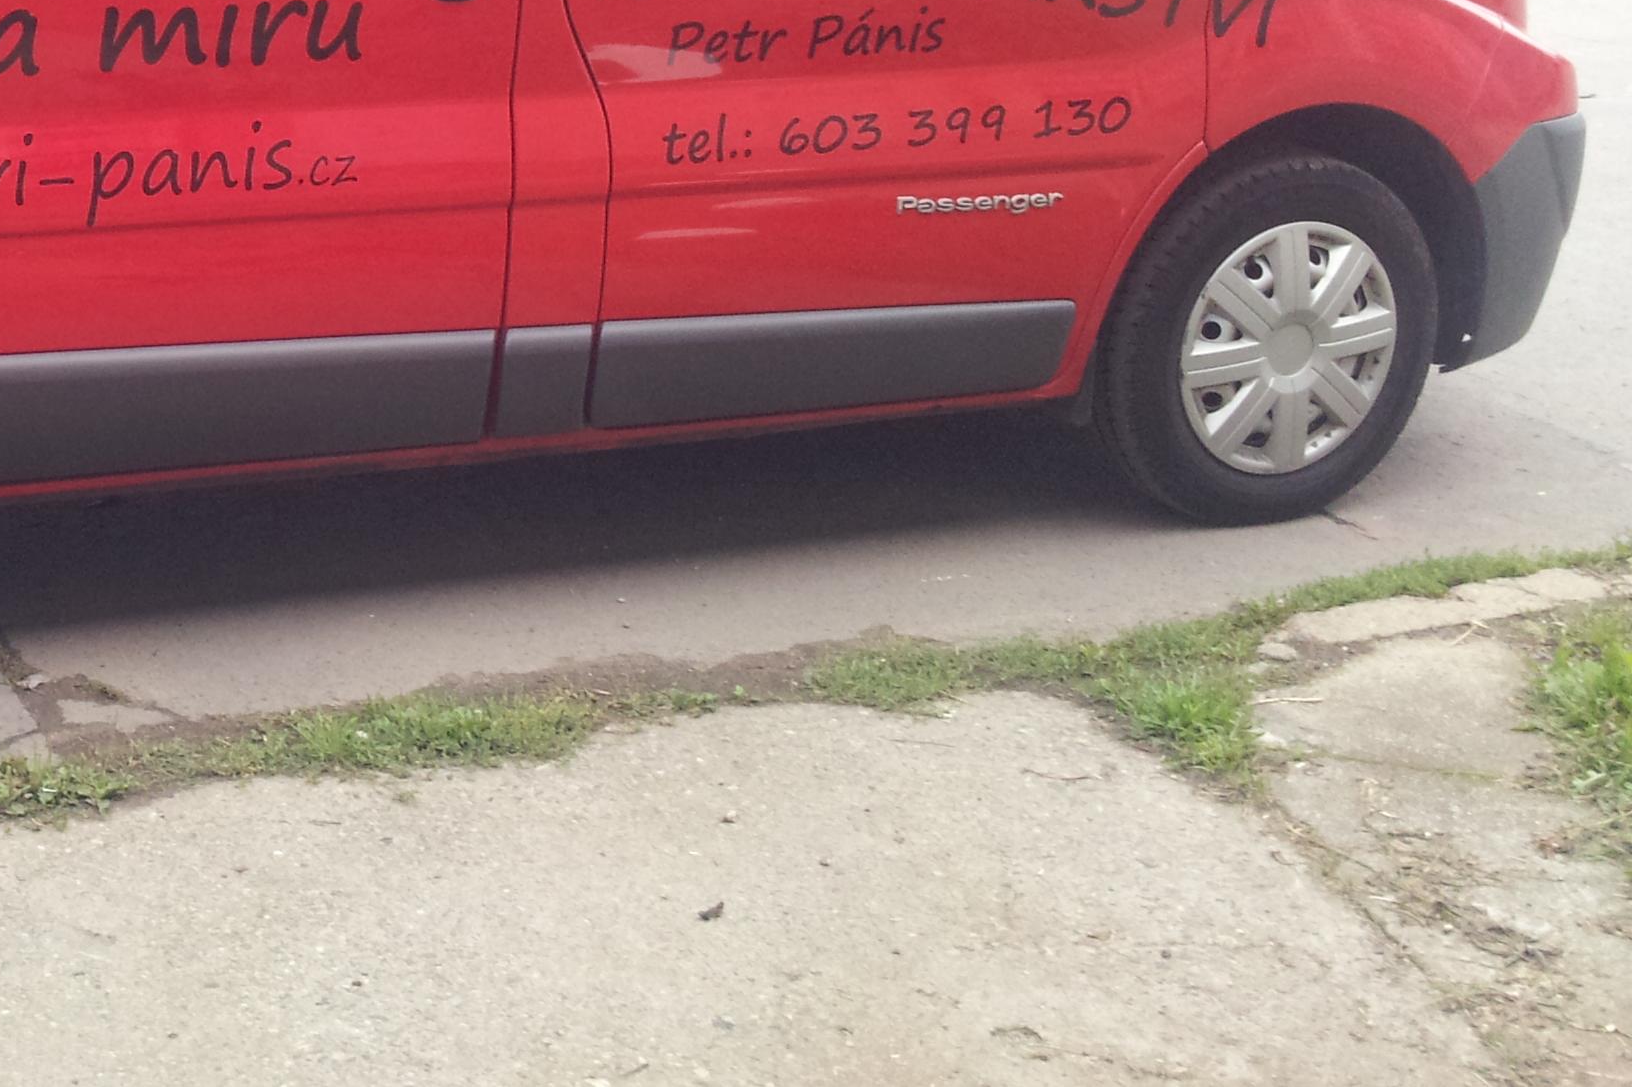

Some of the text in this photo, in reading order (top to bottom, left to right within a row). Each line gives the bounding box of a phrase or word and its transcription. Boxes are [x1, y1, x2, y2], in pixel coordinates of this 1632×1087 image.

[668, 5, 946, 66] Petr Pánis
[662, 95, 1133, 167] tel.: 603 399 130
[896, 191, 1065, 215] Passenger
